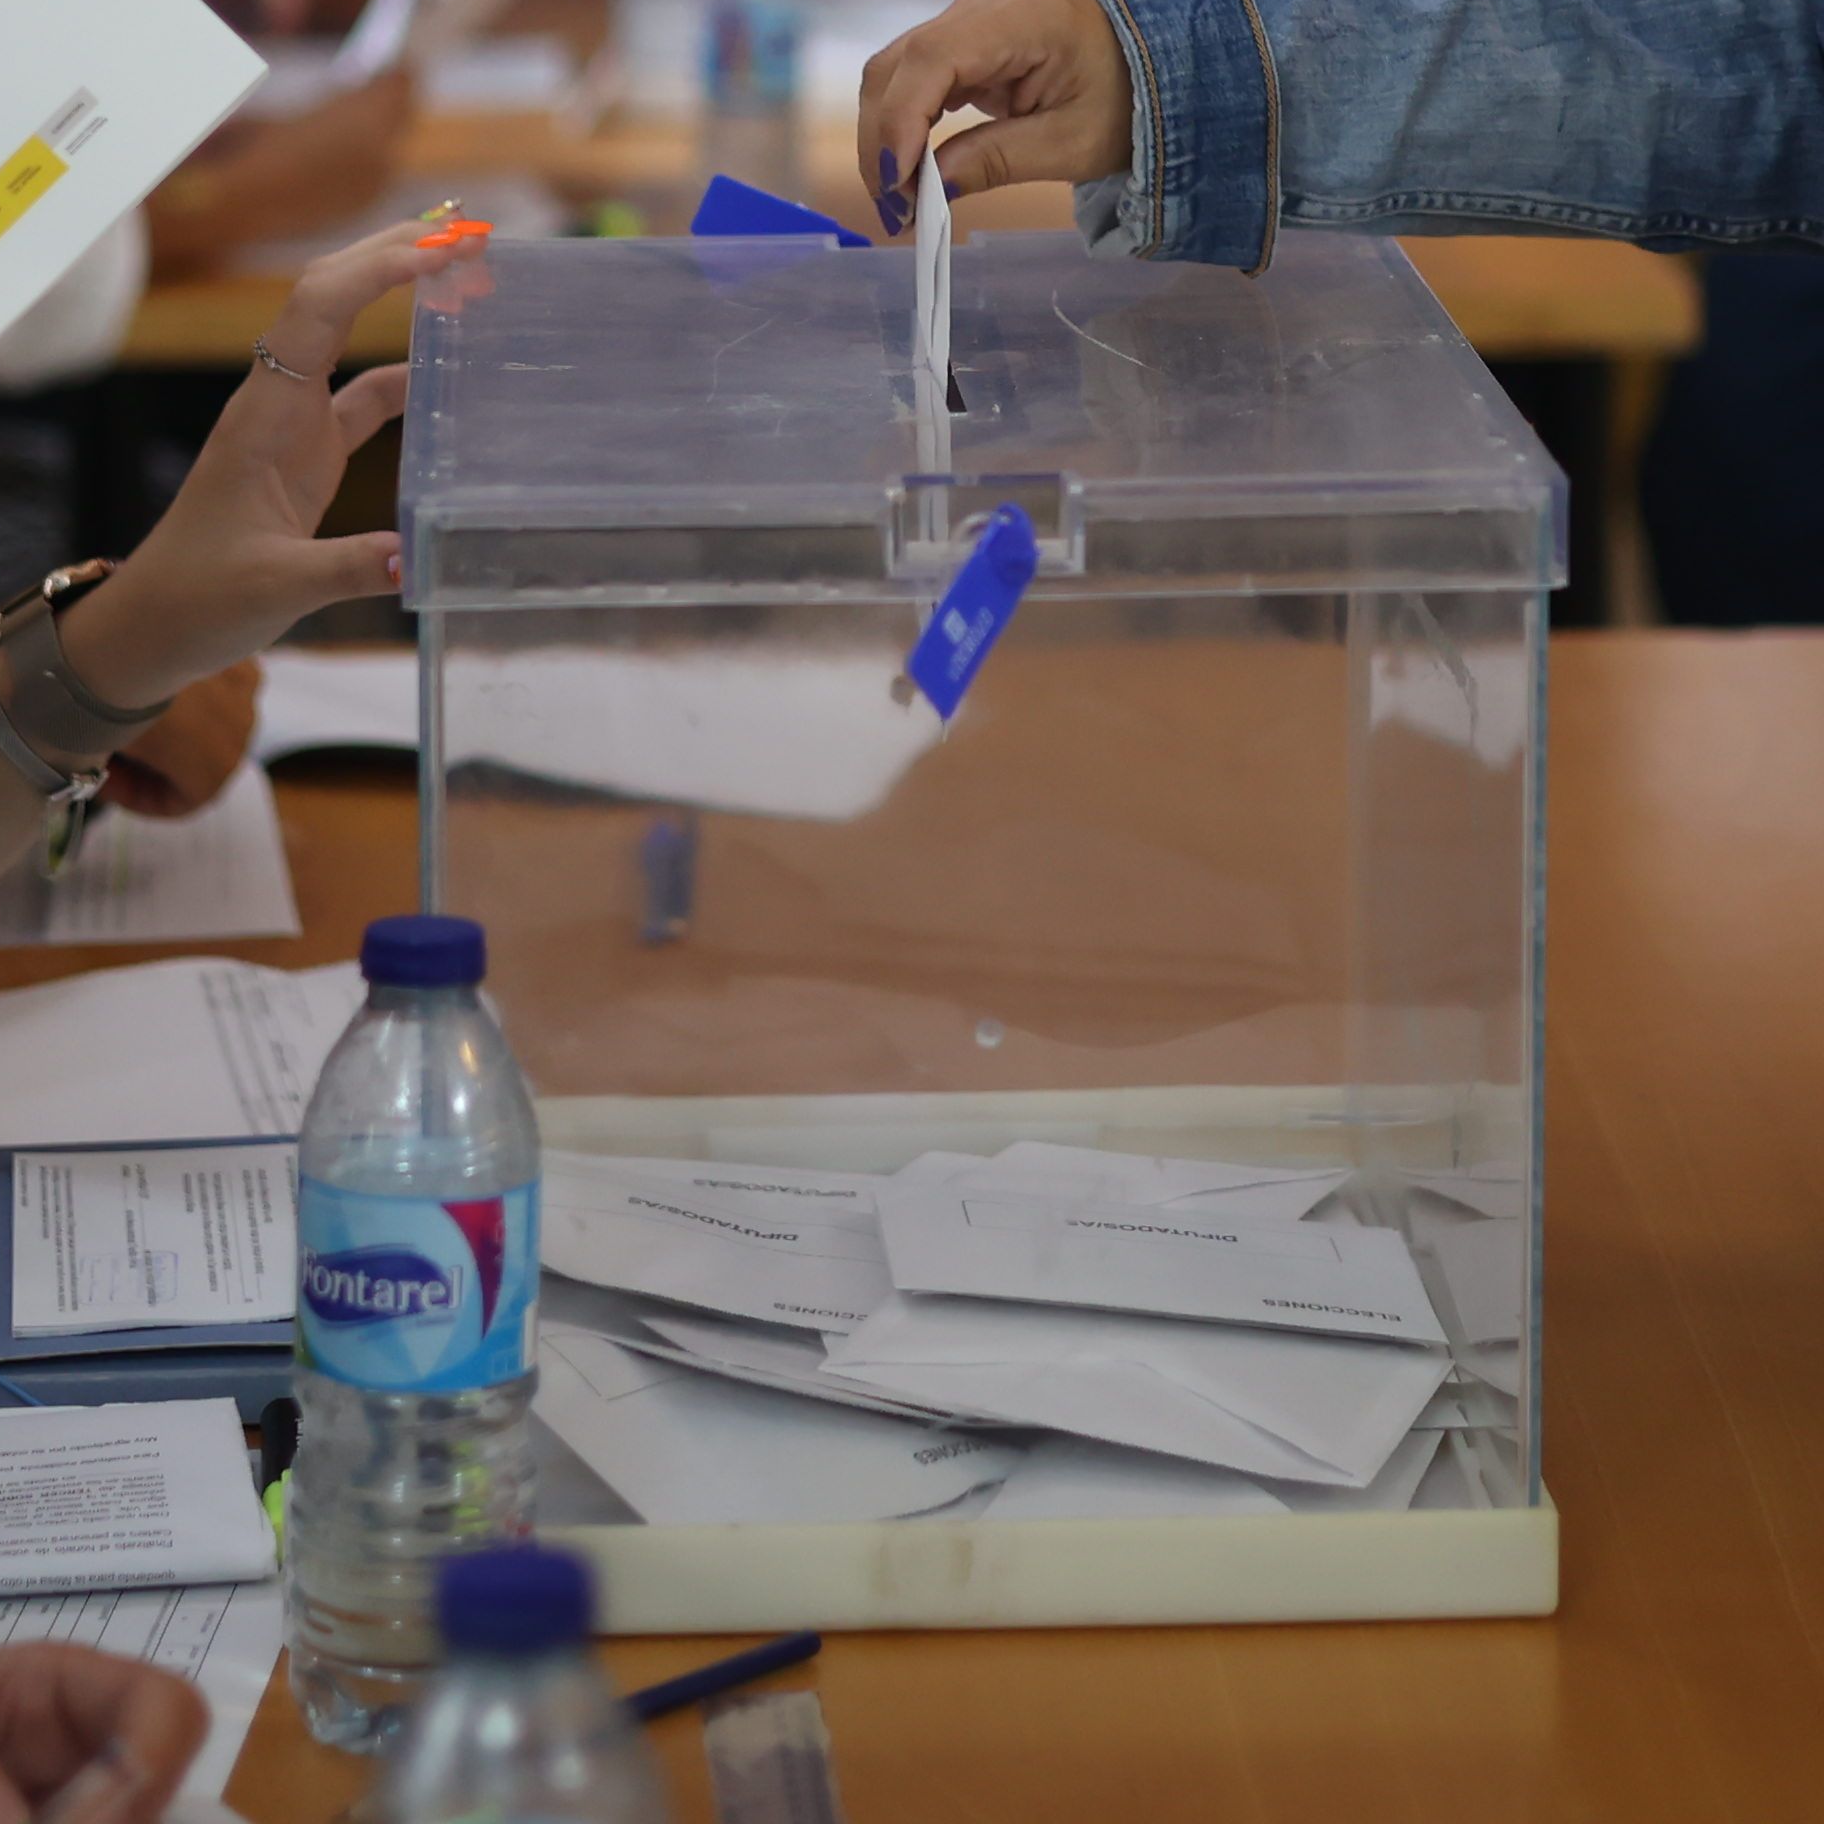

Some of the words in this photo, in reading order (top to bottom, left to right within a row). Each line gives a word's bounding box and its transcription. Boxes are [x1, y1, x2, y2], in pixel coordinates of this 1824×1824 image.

[626, 1195, 800, 1243] DIPUTADOS/AS
[1063, 1218, 1238, 1243] DIPUTADOS/AS
[1261, 1298, 1402, 1323] ELECCIONES
